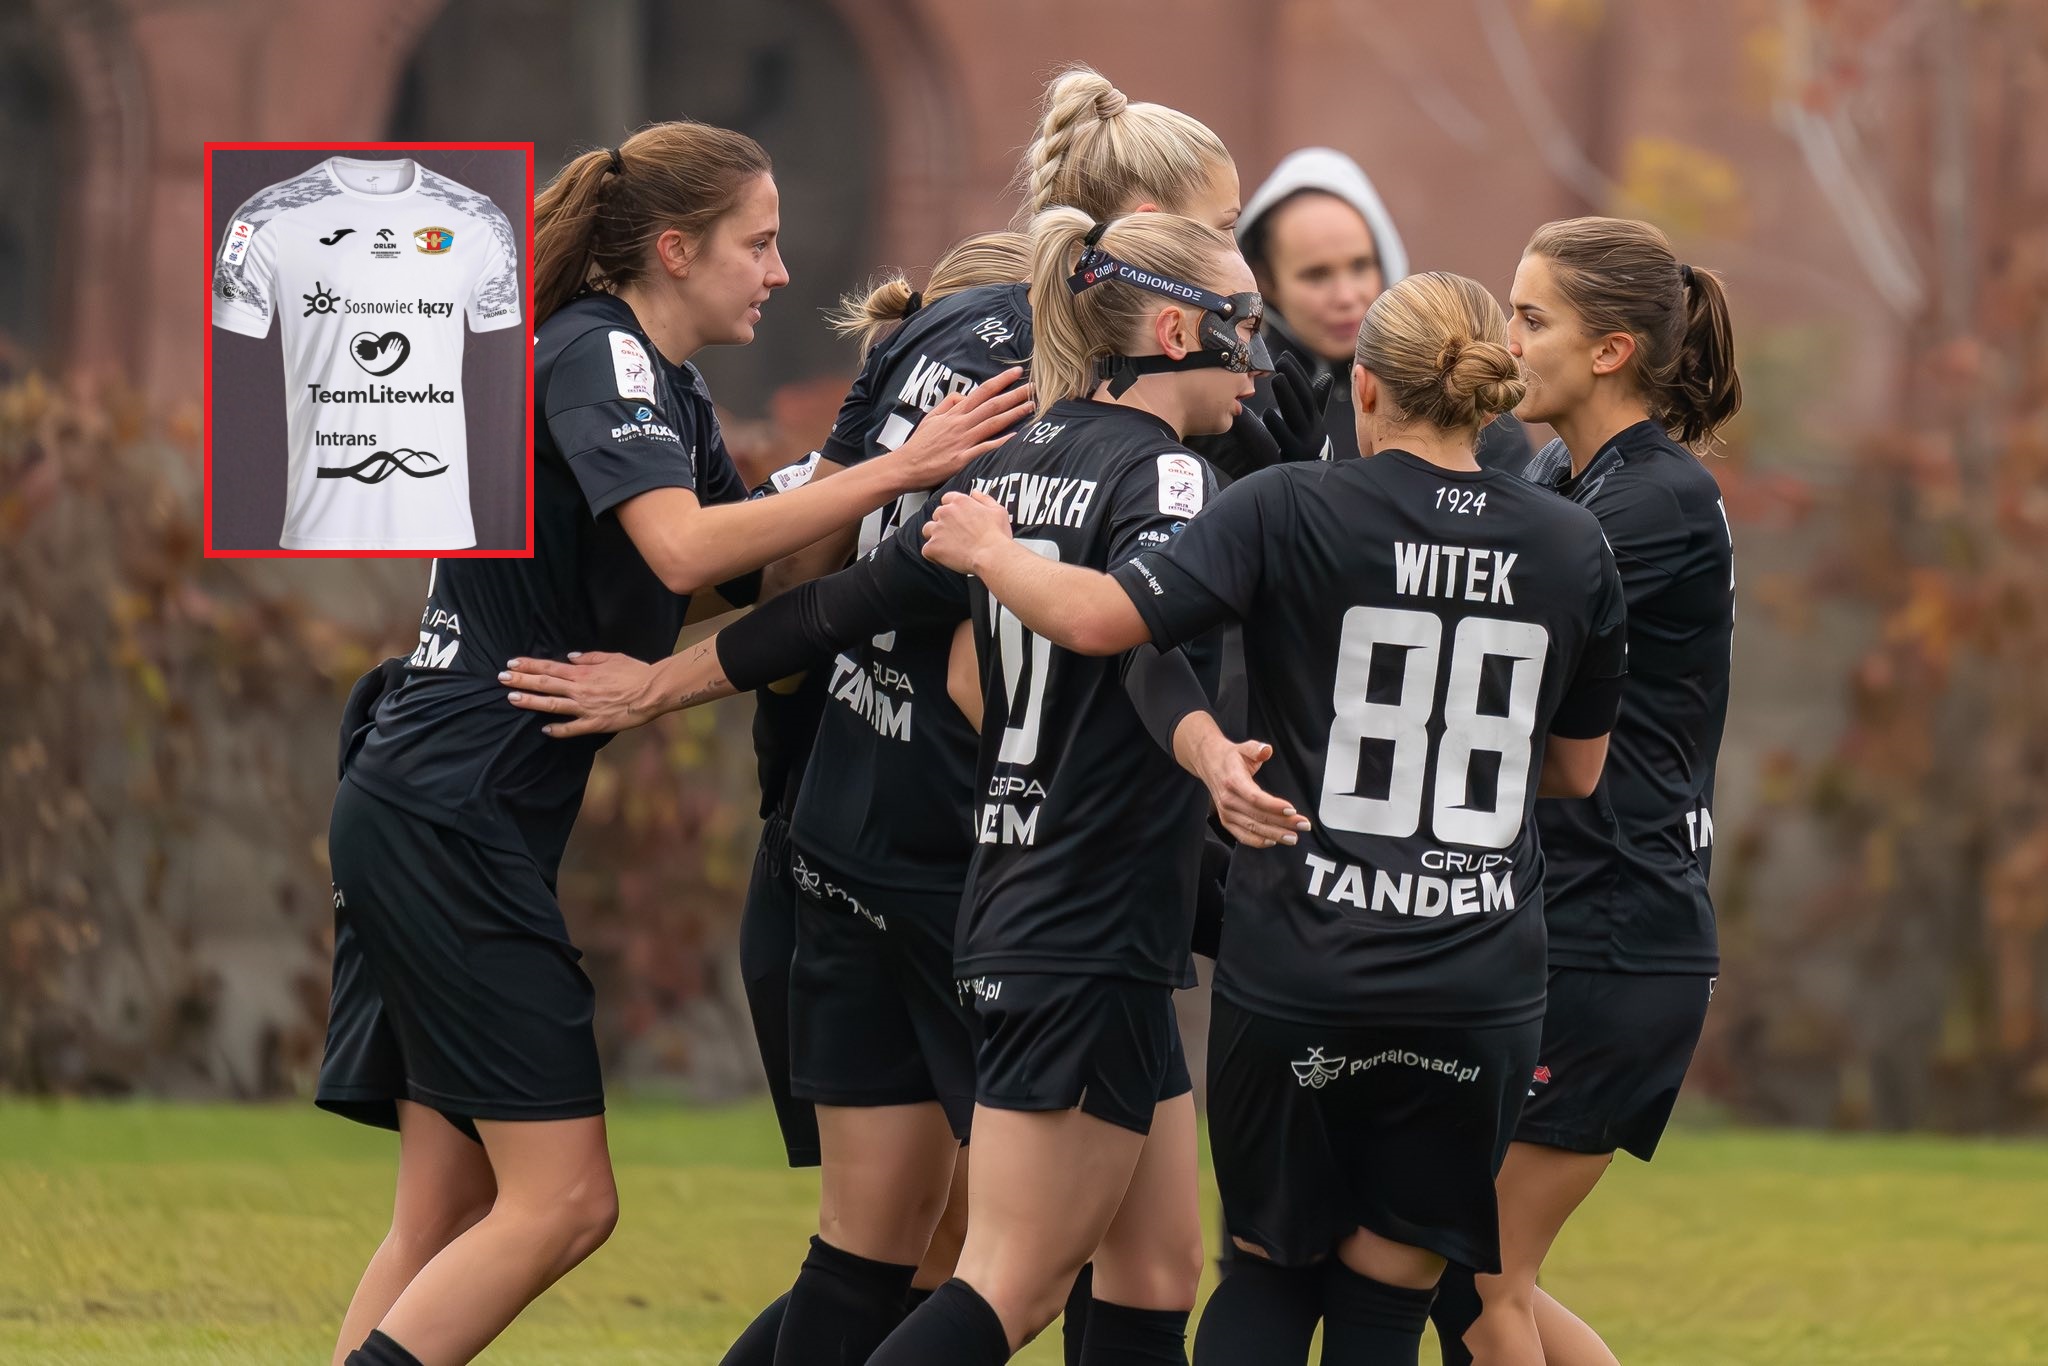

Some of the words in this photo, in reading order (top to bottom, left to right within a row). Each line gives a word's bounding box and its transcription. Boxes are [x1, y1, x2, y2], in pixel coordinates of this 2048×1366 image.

[1119, 266, 1203, 301] CABIOMEDE
[344, 299, 414, 315] Sosnowiec
[417, 299, 454, 319] łączy
[482, 308, 508, 320] PROMED
[972, 316, 1015, 349] 1924
[307, 384, 455, 404] TeamLitewka
[315, 431, 377, 447] Intrans
[1168, 468, 1194, 477] ORLEN
[1435, 486, 1487, 516] 1924
[1394, 541, 1519, 605] WITEK
[1318, 605, 1549, 849] 88
[1304, 852, 1516, 918] TANDEM
